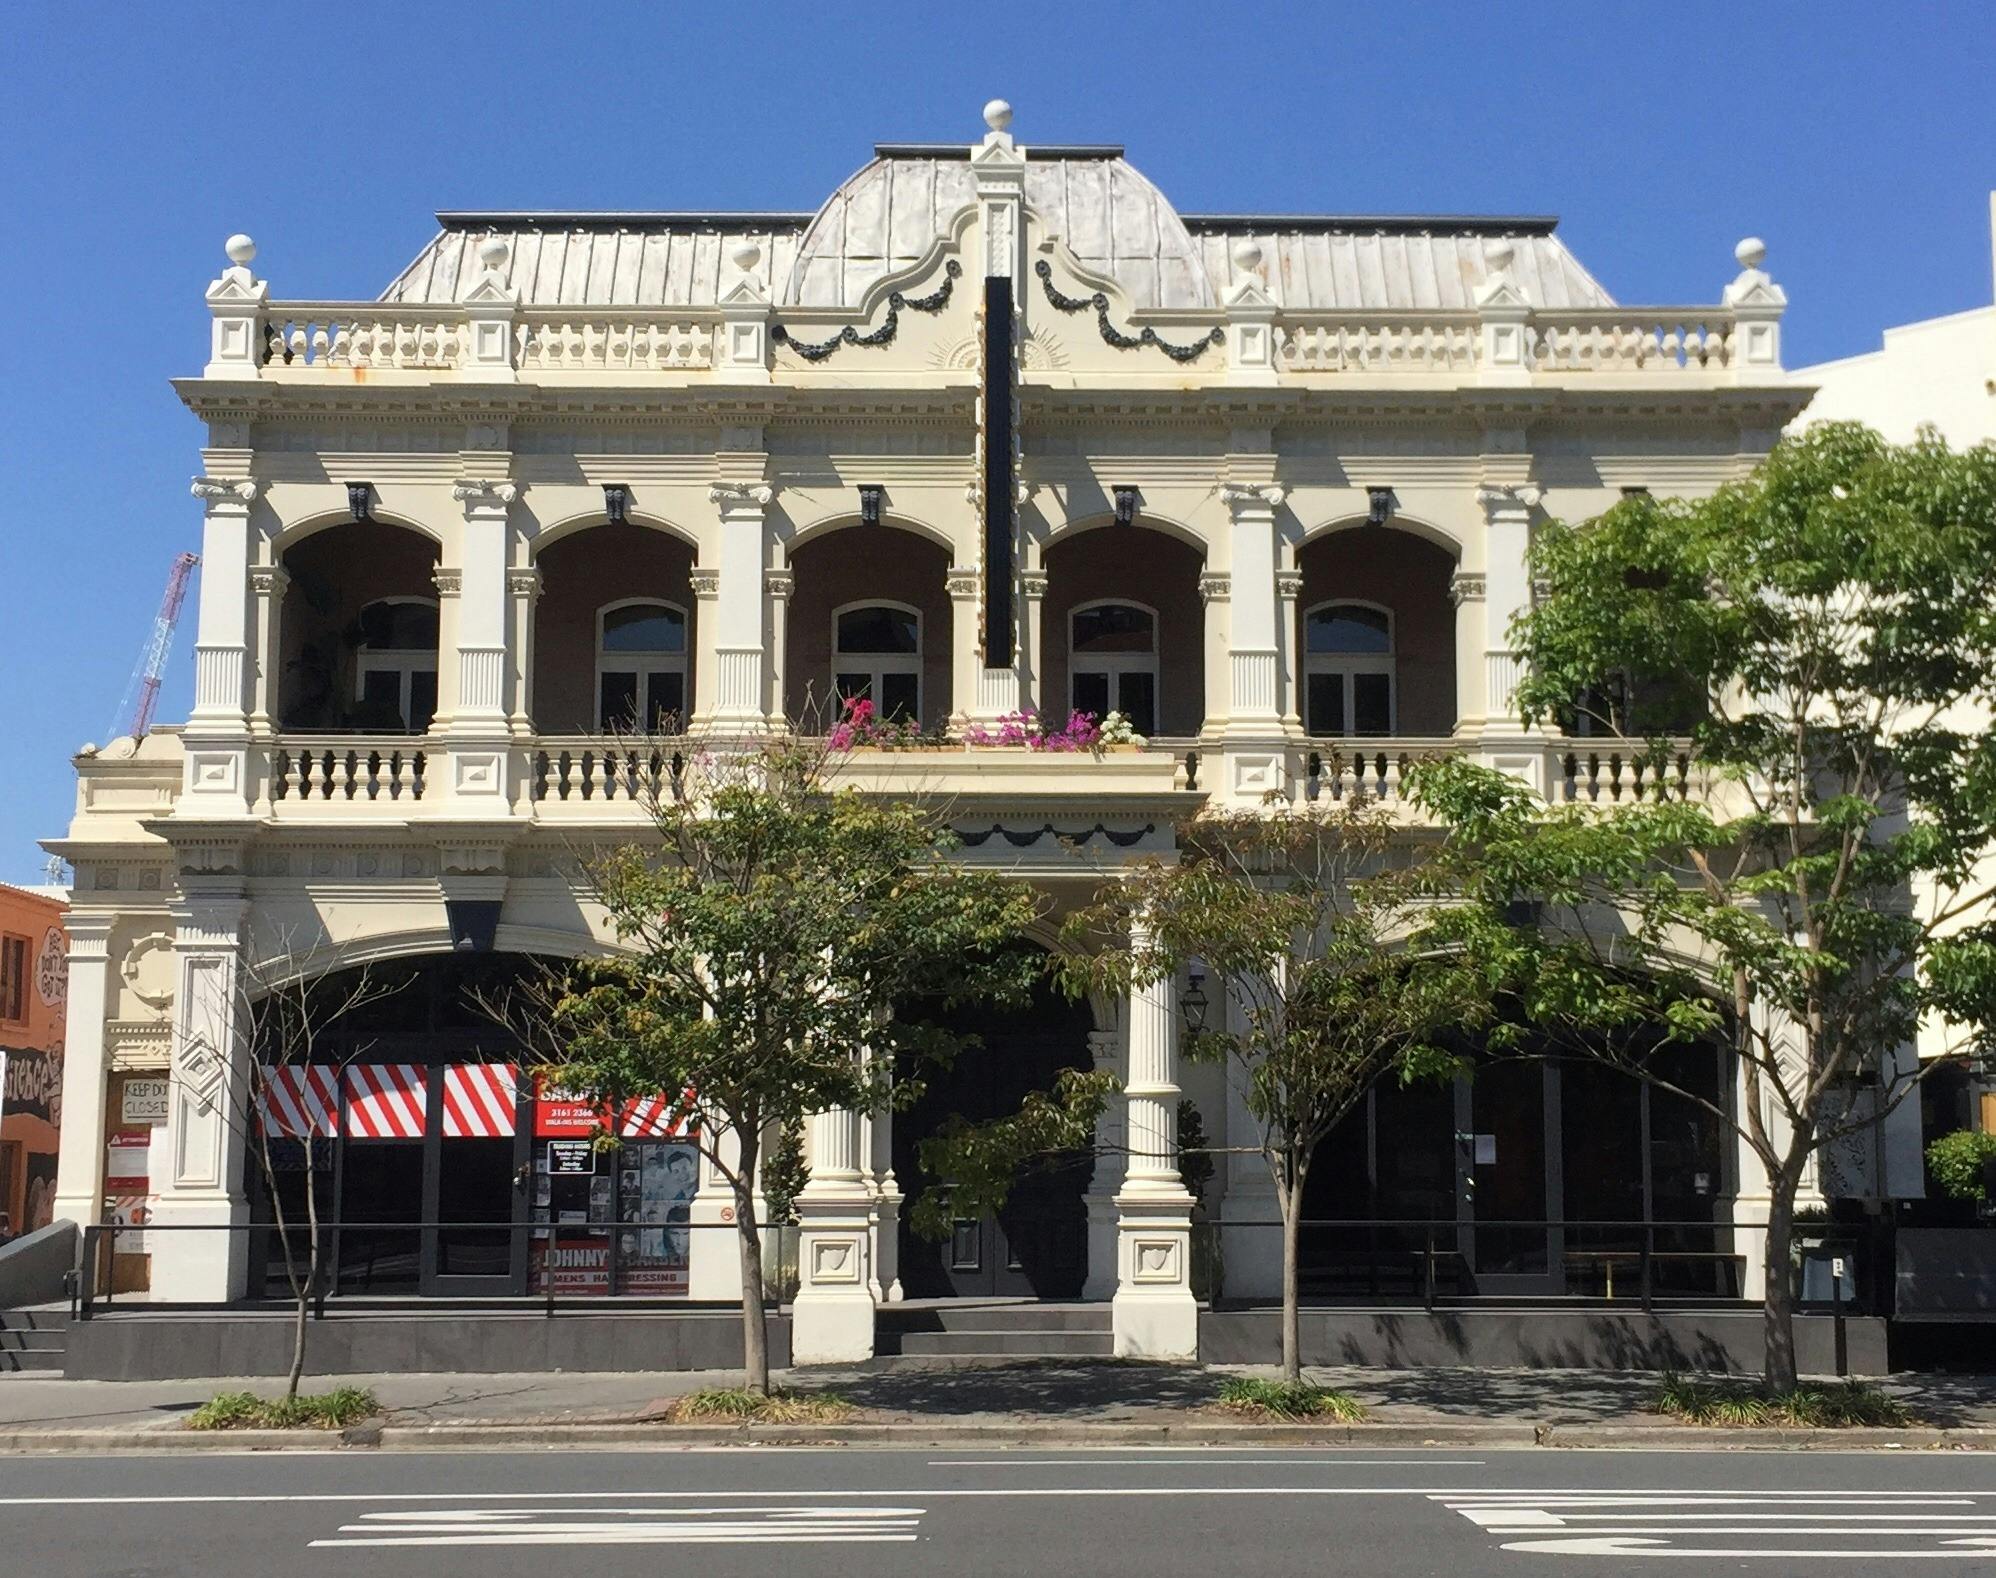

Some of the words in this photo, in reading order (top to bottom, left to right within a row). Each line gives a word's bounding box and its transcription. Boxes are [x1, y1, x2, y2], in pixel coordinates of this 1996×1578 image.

[125, 1082, 150, 1097] KEEP
[152, 1083, 169, 1097] DO
[125, 1101, 169, 1114] CLOSED
[551, 1108, 571, 1117] 3161
[553, 1274, 585, 1283] MENS
